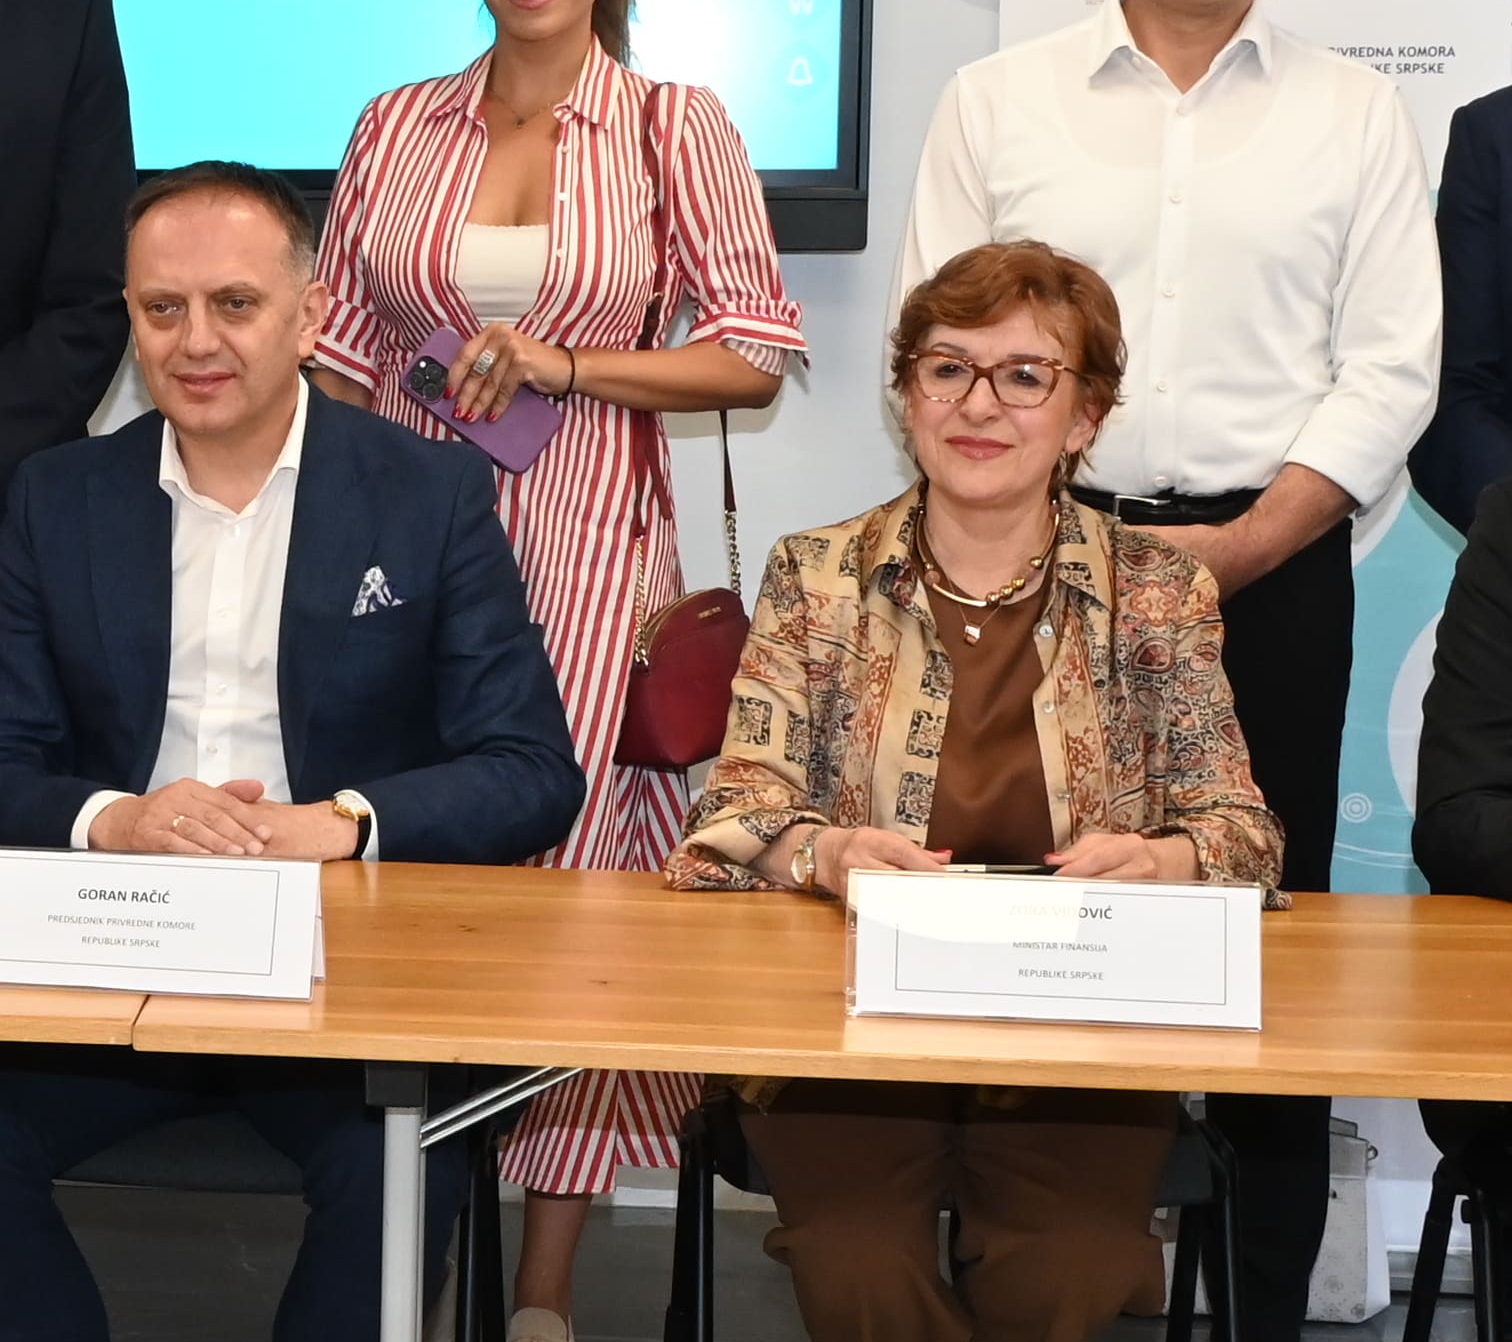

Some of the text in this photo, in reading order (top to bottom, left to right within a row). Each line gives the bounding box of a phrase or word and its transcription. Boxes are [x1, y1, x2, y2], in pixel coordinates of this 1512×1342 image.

[1397, 45, 1456, 58] KOMORA
[1395, 63, 1446, 75] SRPSKE
[77, 888, 170, 905] GORAN RAČIĆ
[47, 914, 196, 930] PREDSJEDNIK PRIVREDNE KOMORE
[81, 935, 161, 948] REPUBLIKE SRPSKE
[1018, 968, 1104, 980] REPUBLIKE SRPSKE
